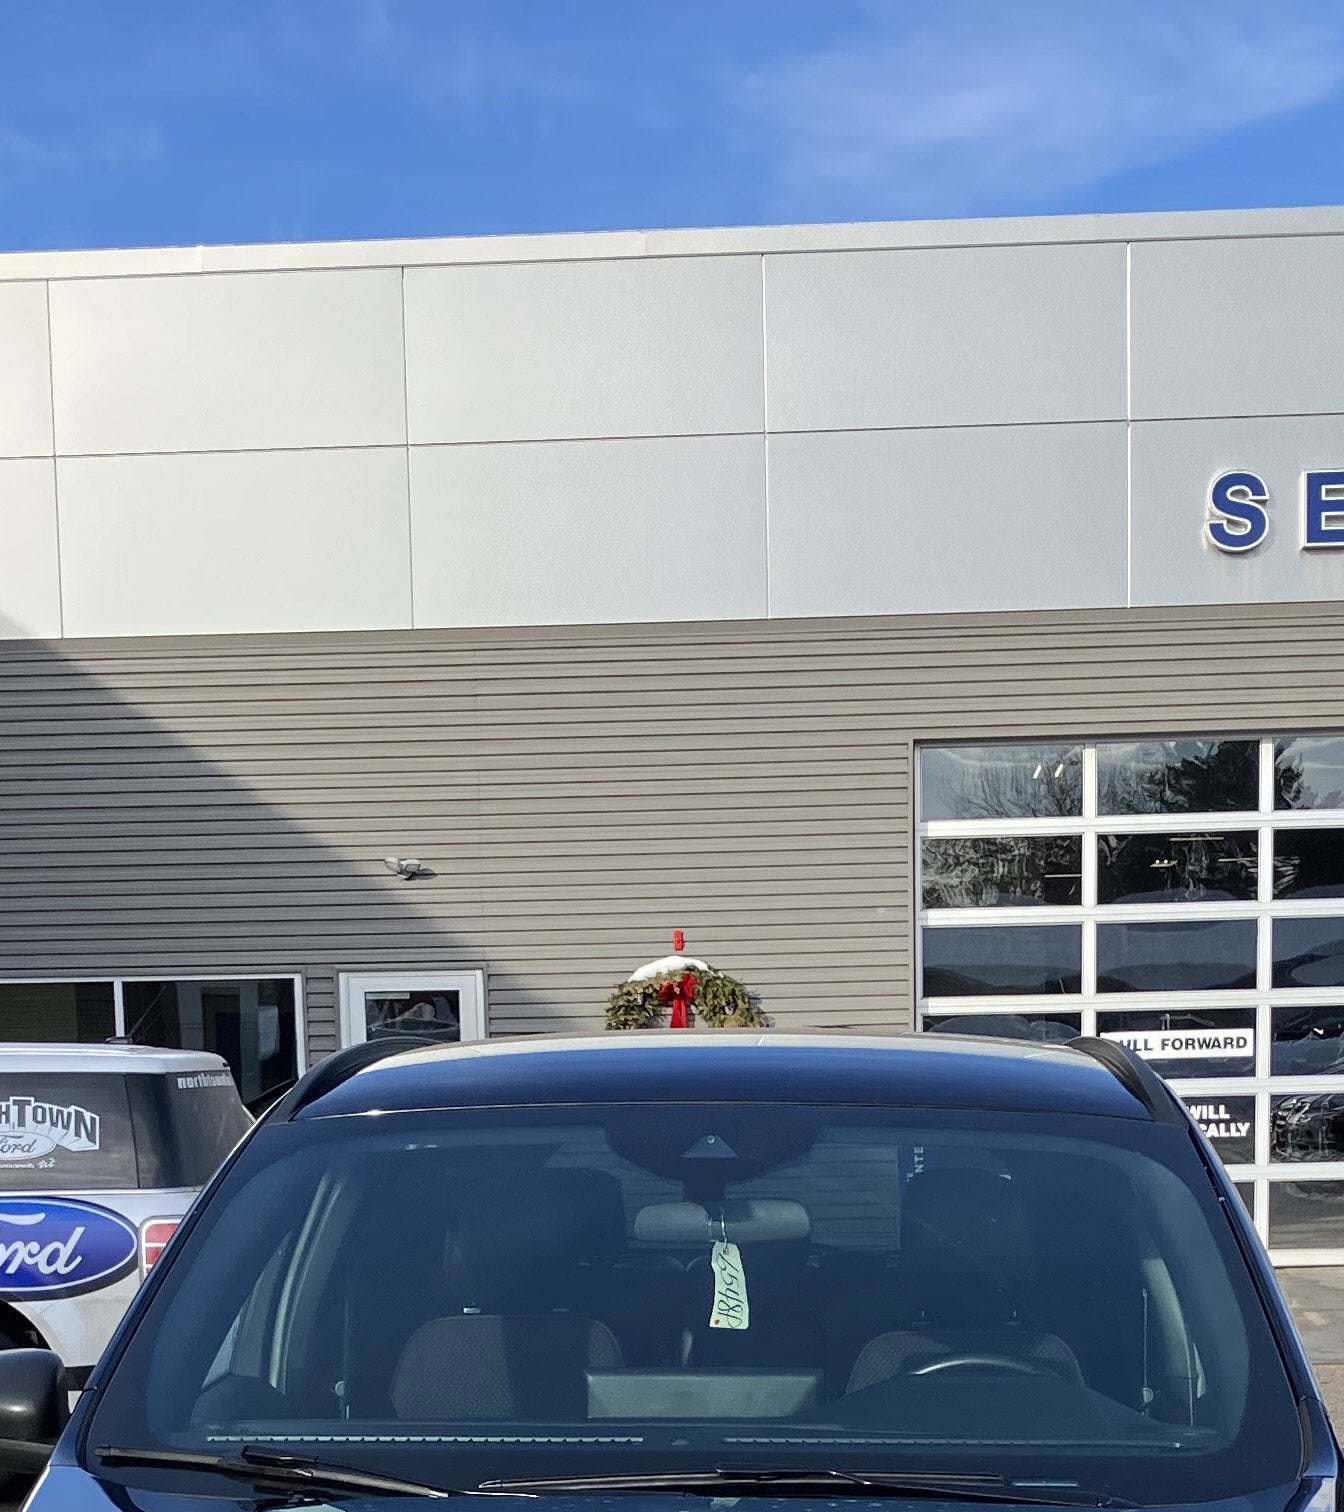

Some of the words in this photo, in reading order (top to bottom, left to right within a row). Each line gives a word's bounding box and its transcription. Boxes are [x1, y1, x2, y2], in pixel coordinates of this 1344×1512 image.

[1120, 1038, 1153, 1051] ULL
[1161, 1036, 1247, 1050] FORWARD
[1186, 1104, 1230, 1119] WILL
